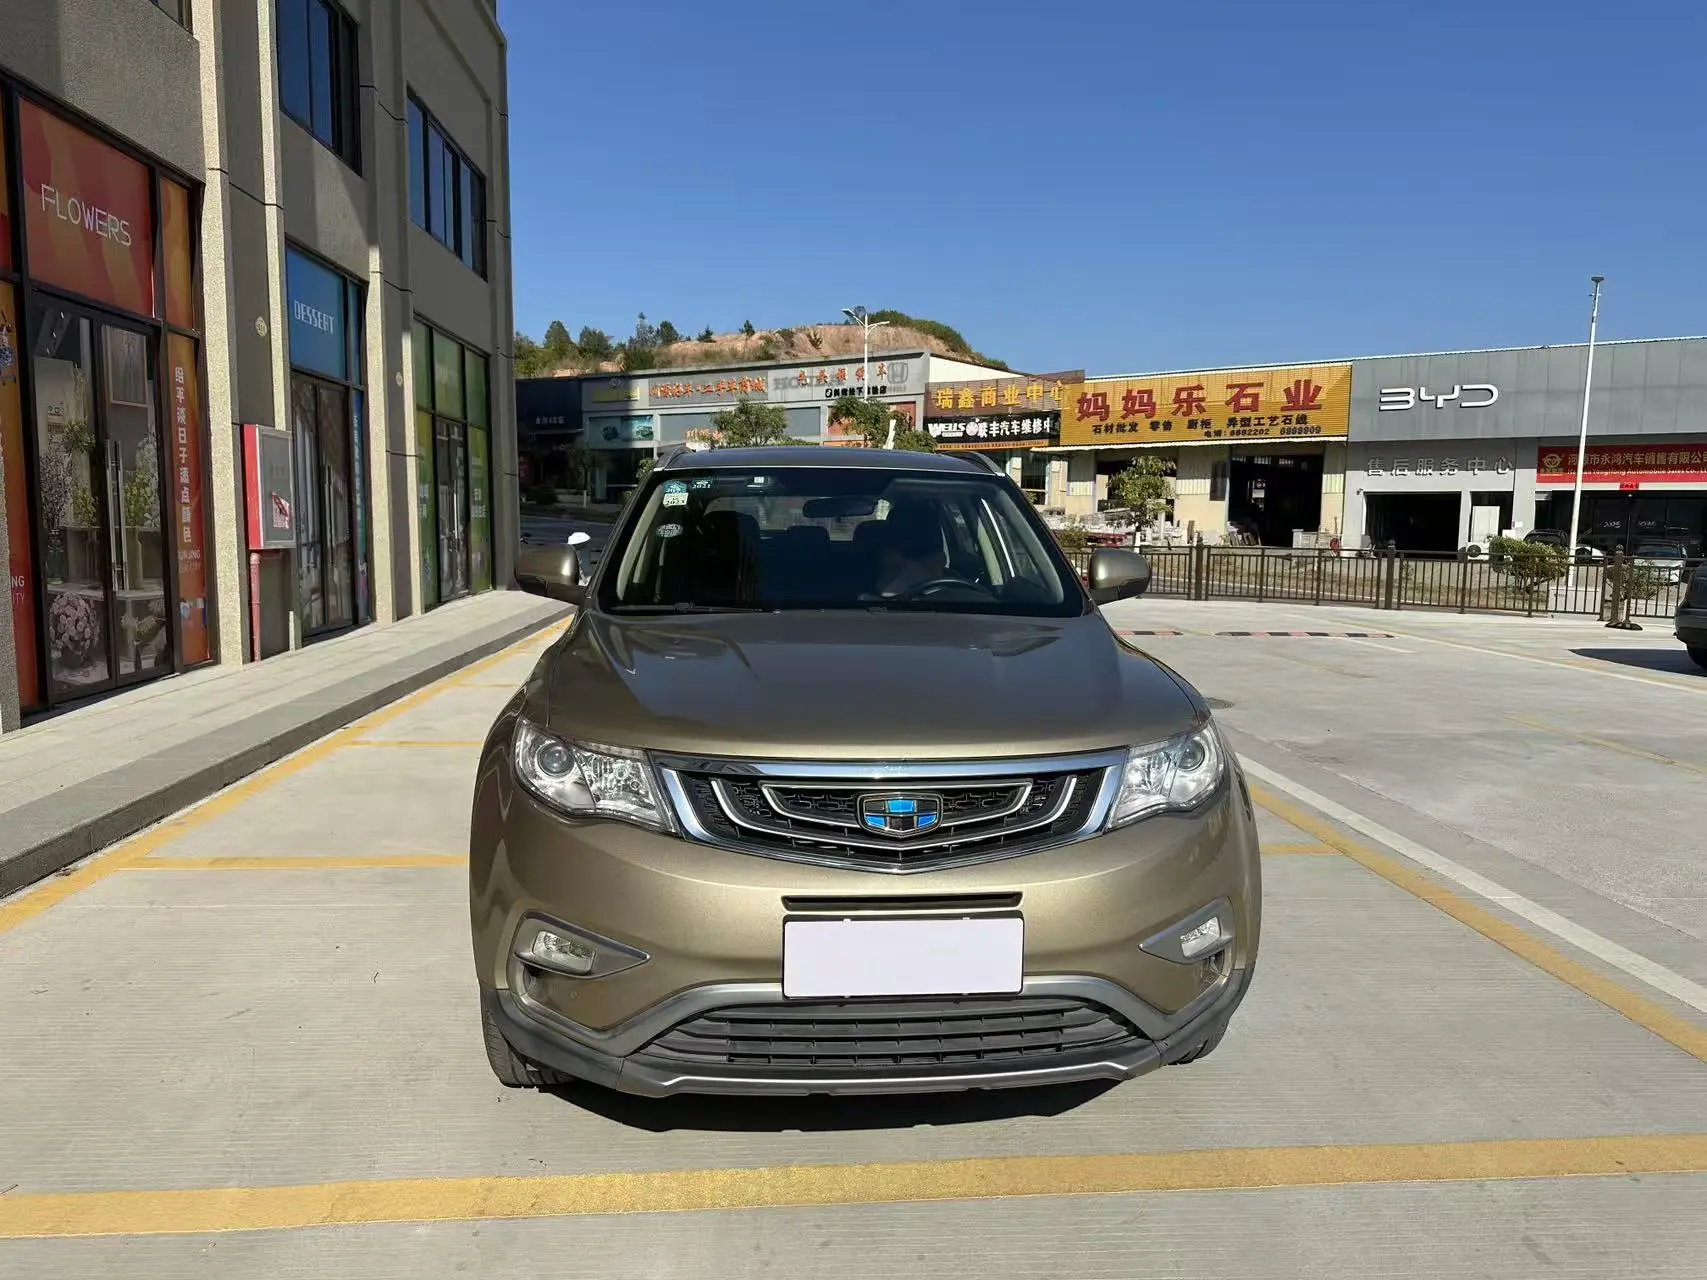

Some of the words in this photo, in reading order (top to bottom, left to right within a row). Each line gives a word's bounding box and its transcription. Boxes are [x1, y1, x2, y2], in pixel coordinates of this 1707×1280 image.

[41, 183, 131, 246] FLOWERS
[294, 299, 334, 334] DESSERT
[936, 380, 1066, 409] 瑞鑫商业中心
[1076, 379, 1323, 422] 妈妈乐石业
[1379, 384, 1499, 411] BYD
[1092, 421, 1138, 434] 石材批发
[1150, 419, 1173, 432] 零售
[1367, 456, 1514, 477] 售后服务中心
